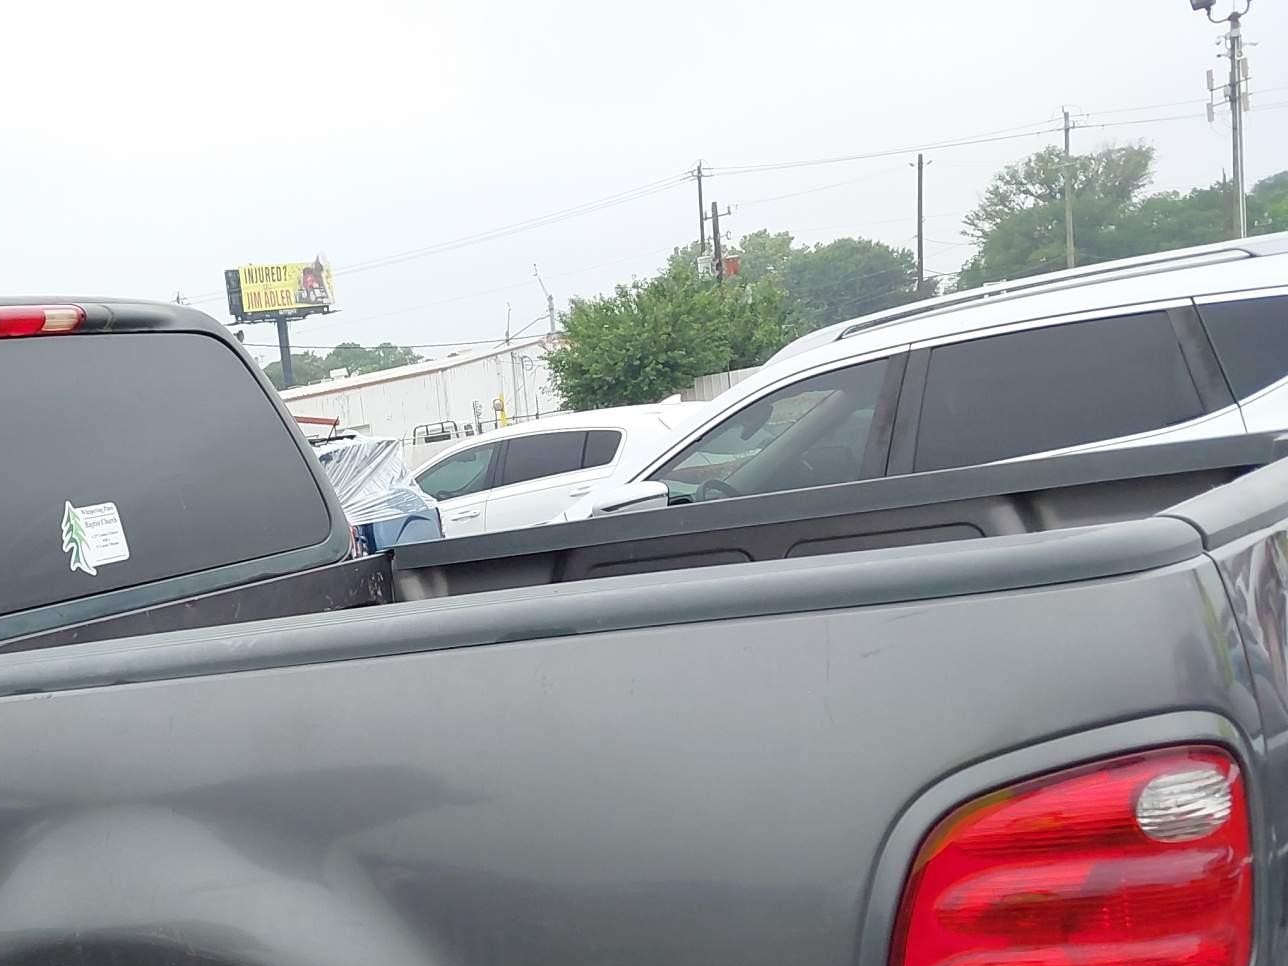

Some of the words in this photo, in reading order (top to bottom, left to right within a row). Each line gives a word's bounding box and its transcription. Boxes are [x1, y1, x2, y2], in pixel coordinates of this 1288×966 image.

[244, 266, 287, 284] INJURED?
[247, 292, 262, 309] JIM
[265, 289, 293, 307] ADLER
